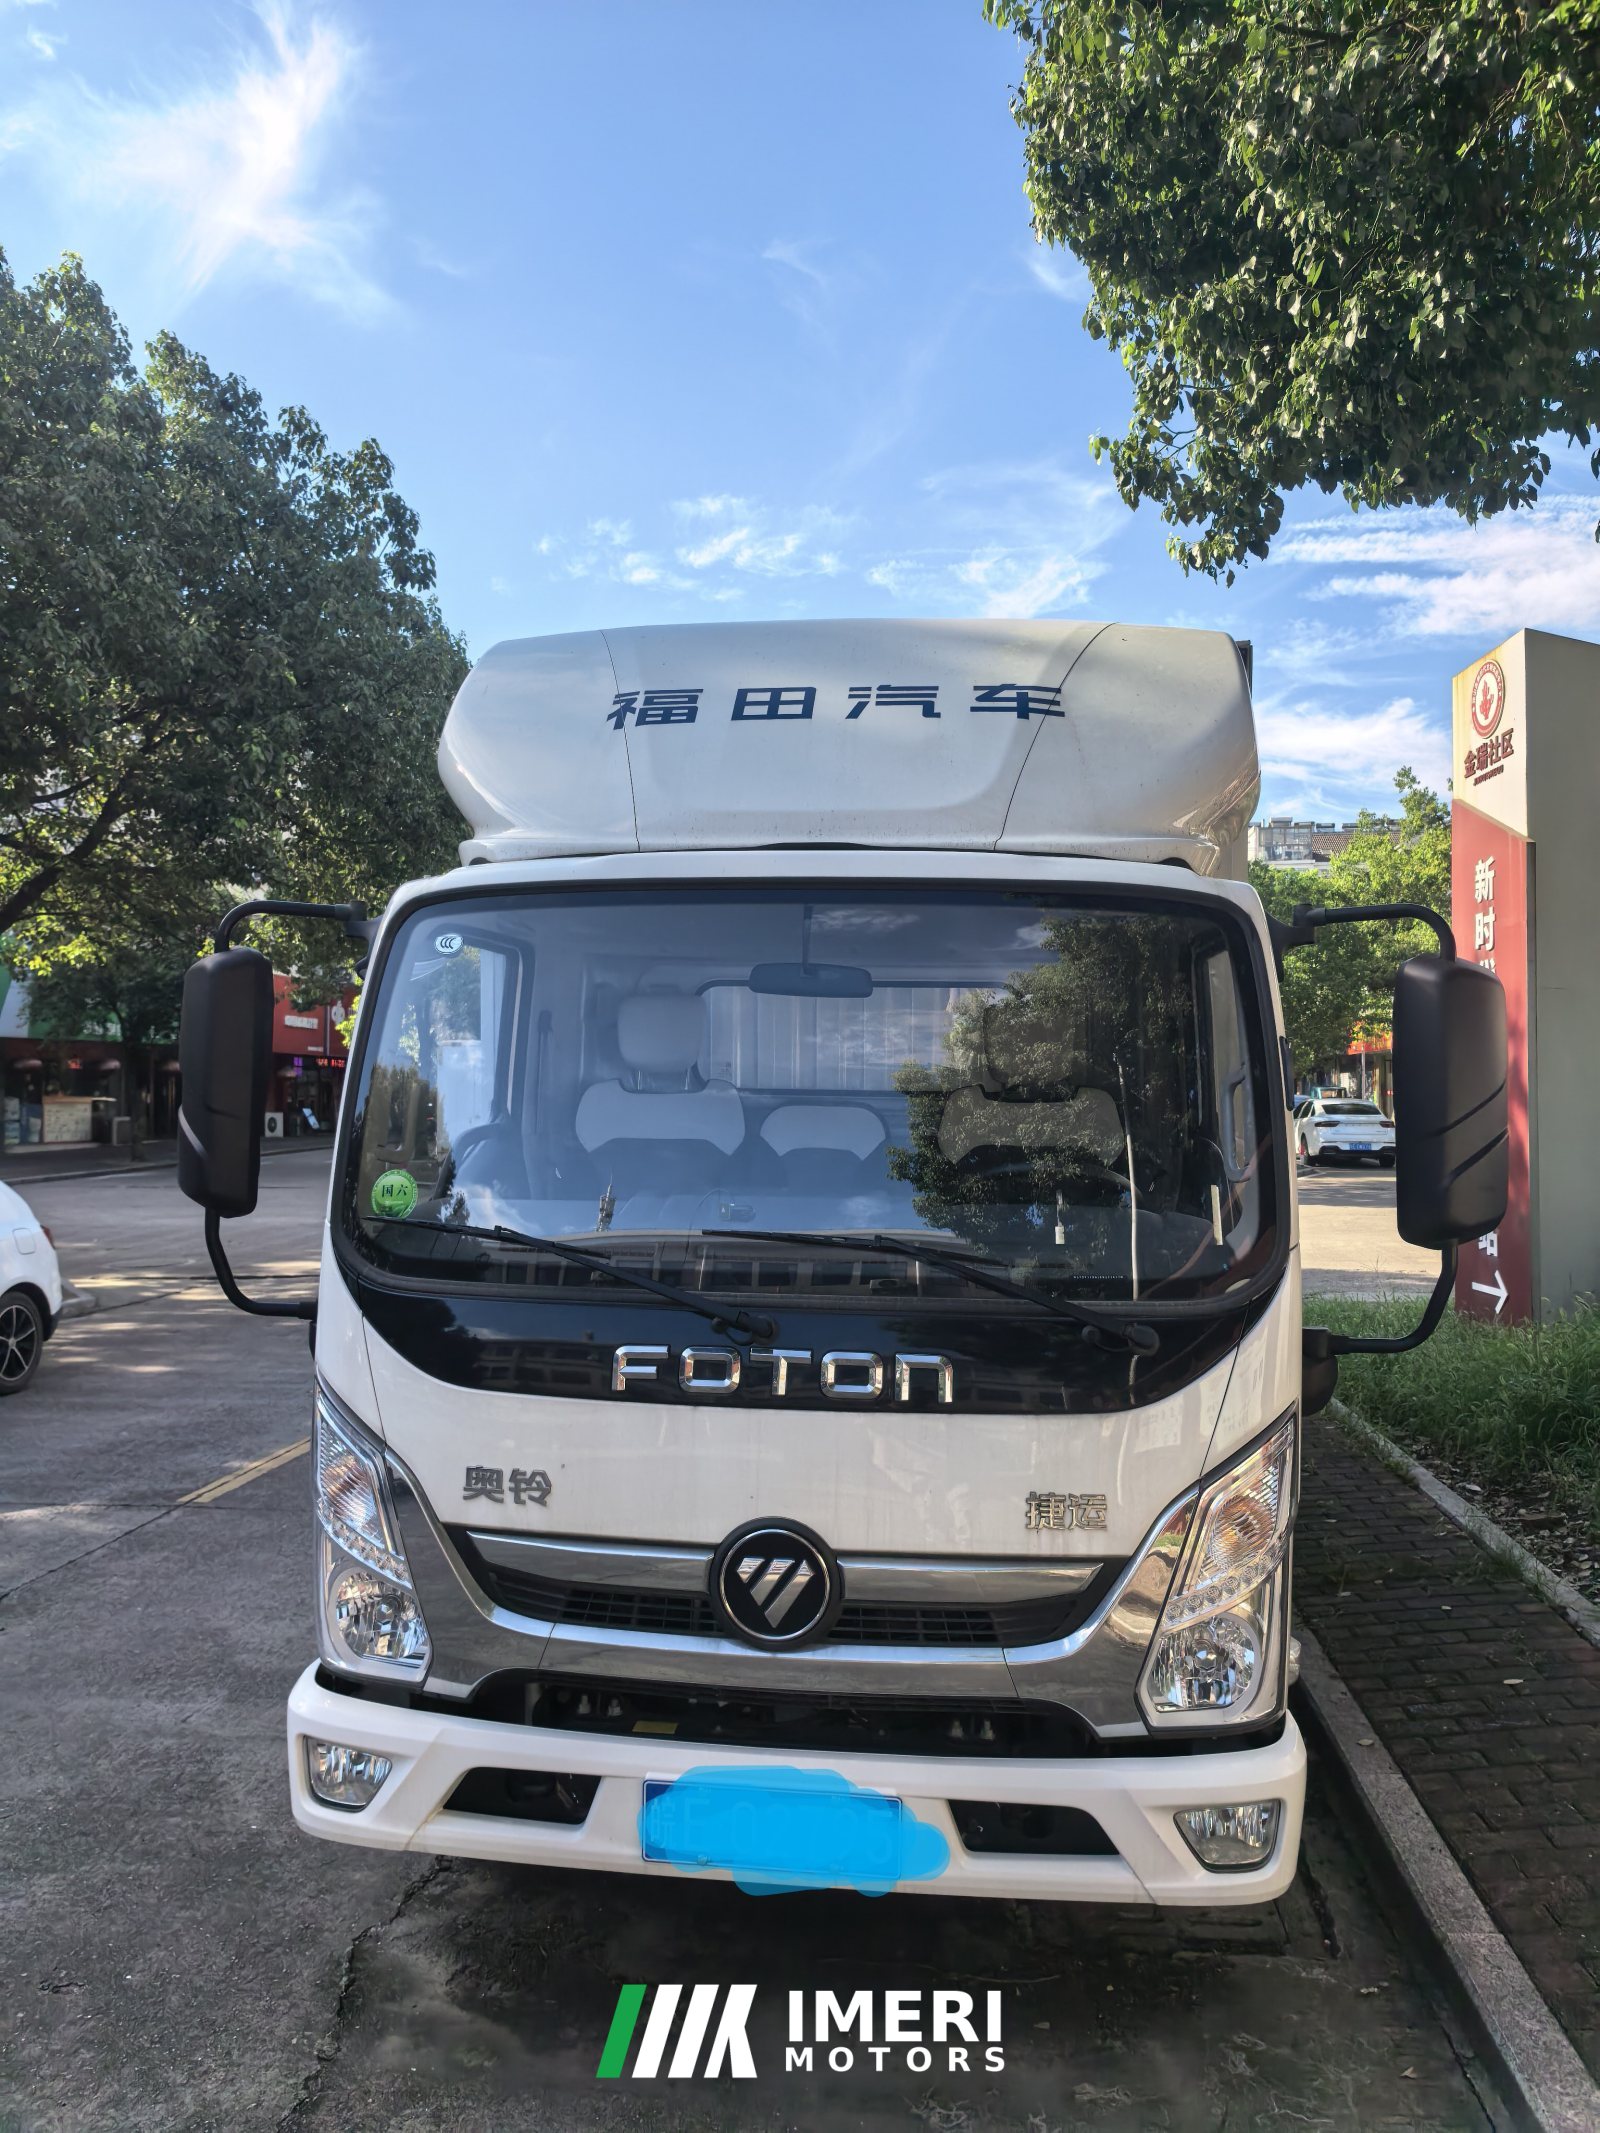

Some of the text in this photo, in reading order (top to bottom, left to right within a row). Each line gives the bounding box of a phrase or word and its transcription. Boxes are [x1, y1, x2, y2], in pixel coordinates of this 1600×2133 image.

[606, 684, 1066, 730] 福田汽车
[1463, 727, 1514, 779] 金瑞社区
[381, 1183, 409, 1198] 国六
[611, 1344, 954, 1403] FOTON
[462, 1465, 552, 1507] 奥铃
[1025, 1491, 1108, 1531] 捷运
